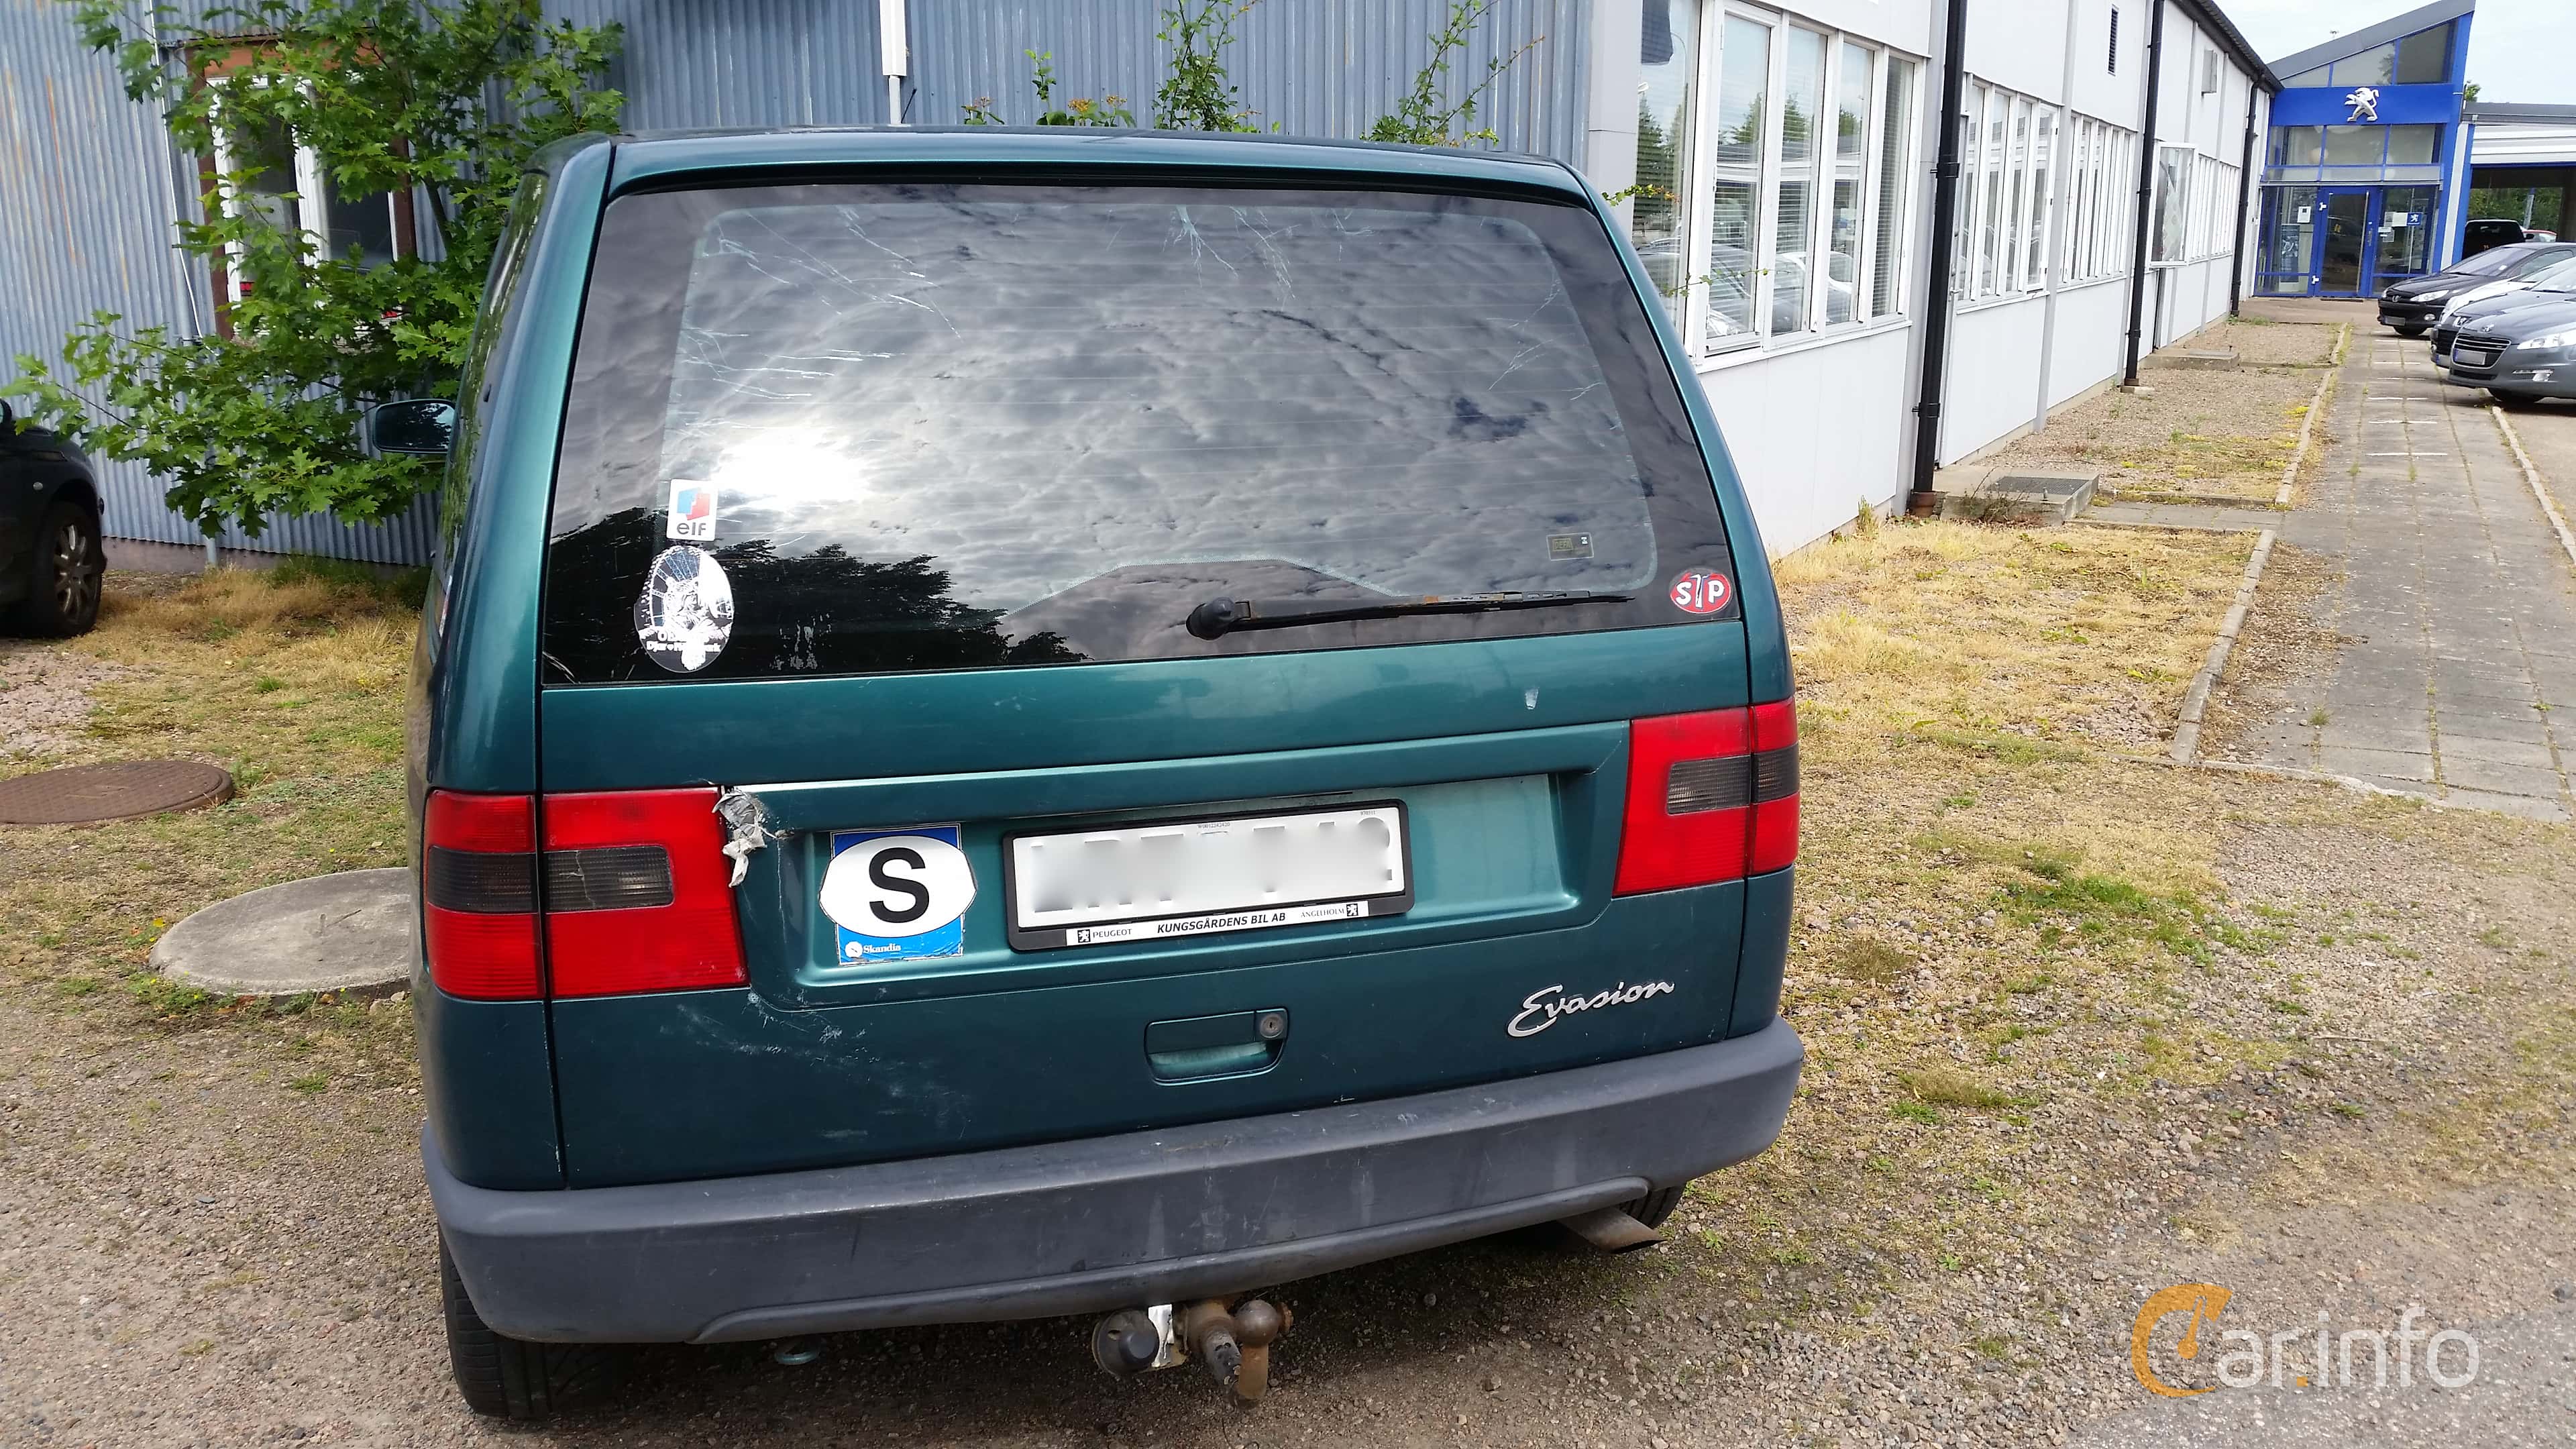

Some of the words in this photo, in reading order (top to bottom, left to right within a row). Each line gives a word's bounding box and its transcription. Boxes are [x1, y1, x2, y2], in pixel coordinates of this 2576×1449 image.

[677, 522, 706, 535] elf
[1676, 574, 1724, 607] STP
[869, 847, 929, 923] S
[1093, 928, 1132, 938] PEUGEOT
[1157, 916, 1248, 933] KUNGSGÅRDENS
[1251, 914, 1269, 924] BIL
[1271, 912, 1286, 922] AB
[863, 943, 901, 953] Skandia
[1507, 981, 1675, 1037] Evasion
